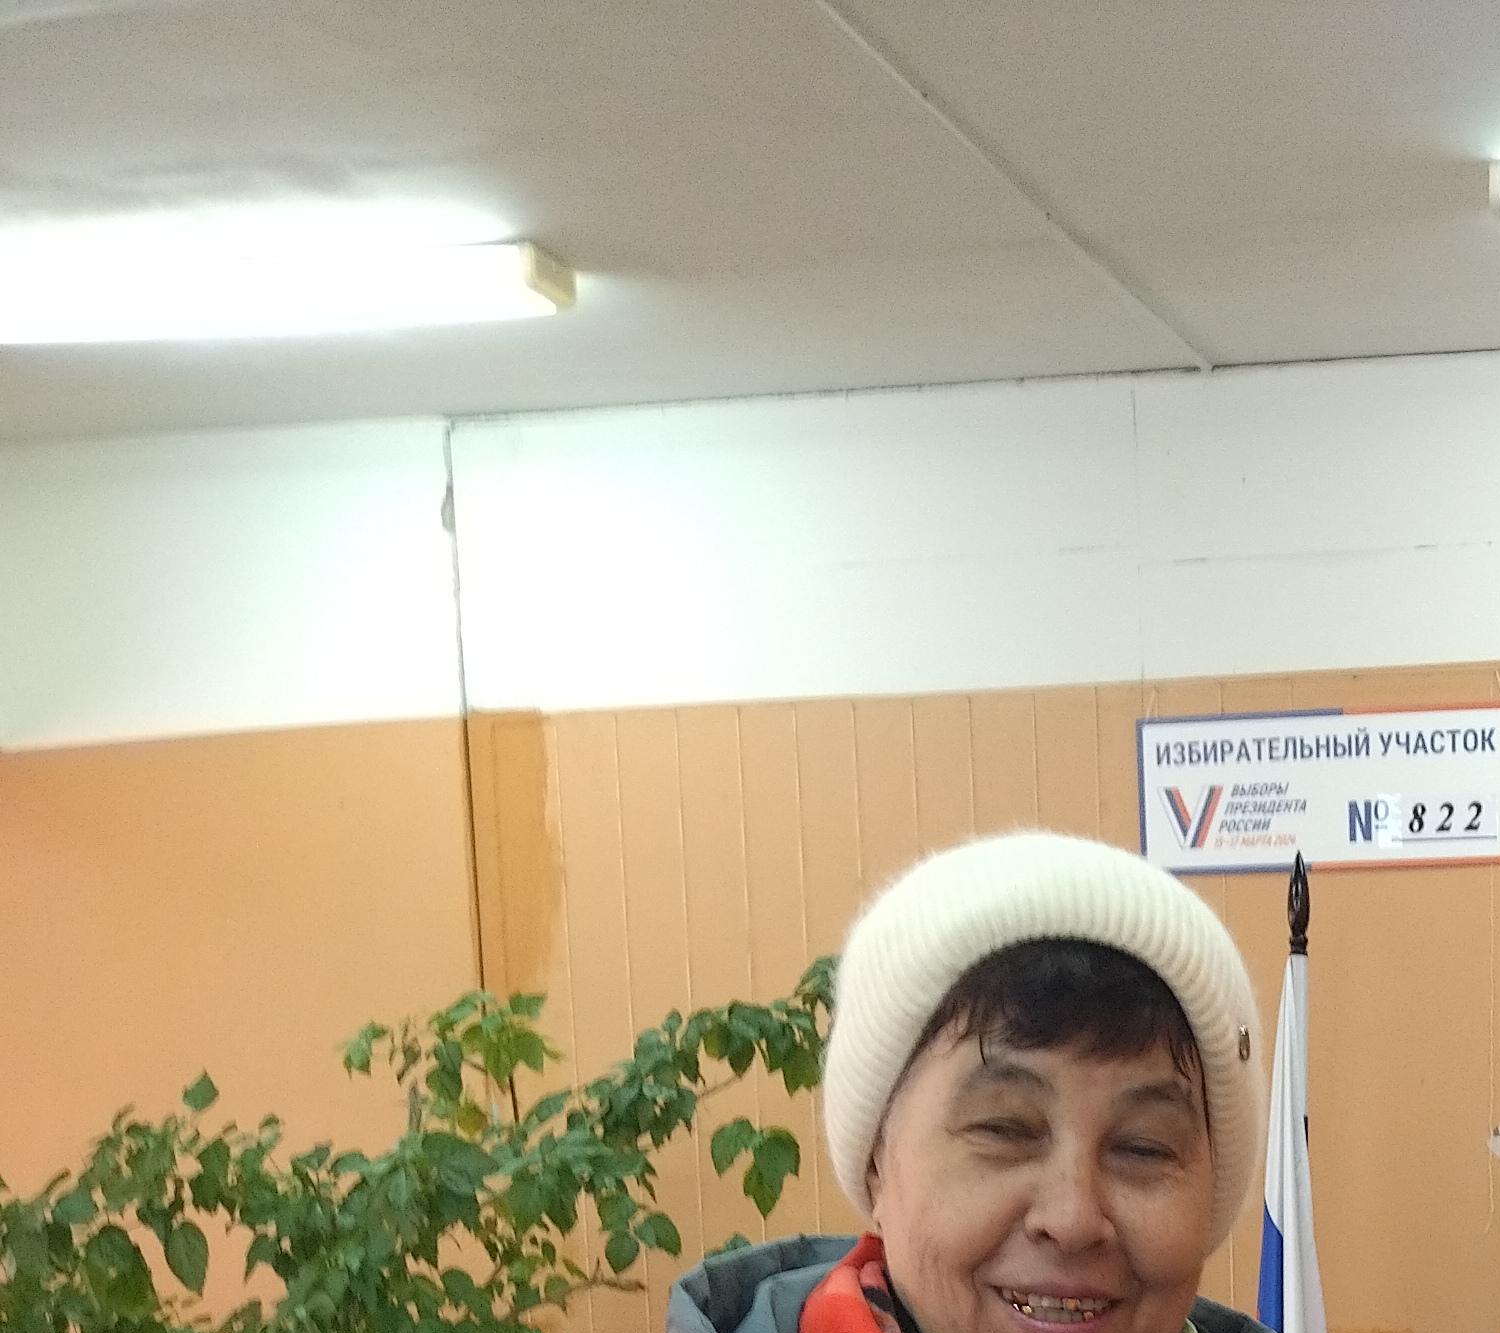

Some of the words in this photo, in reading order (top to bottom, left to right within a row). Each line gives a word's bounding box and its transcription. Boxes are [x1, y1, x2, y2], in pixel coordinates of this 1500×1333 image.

[1155, 728, 1371, 767] ИЗБИРАТЕЛЬНЫЙ
[1380, 728, 1496, 757] УЧАСТОК
[1230, 782, 1289, 798] ВЫБОРЫ
[1224, 799, 1307, 816] ПРЕЗИДЕНТА
[1218, 818, 1272, 834] РОССИИ
[1408, 801, 1483, 834] 822
